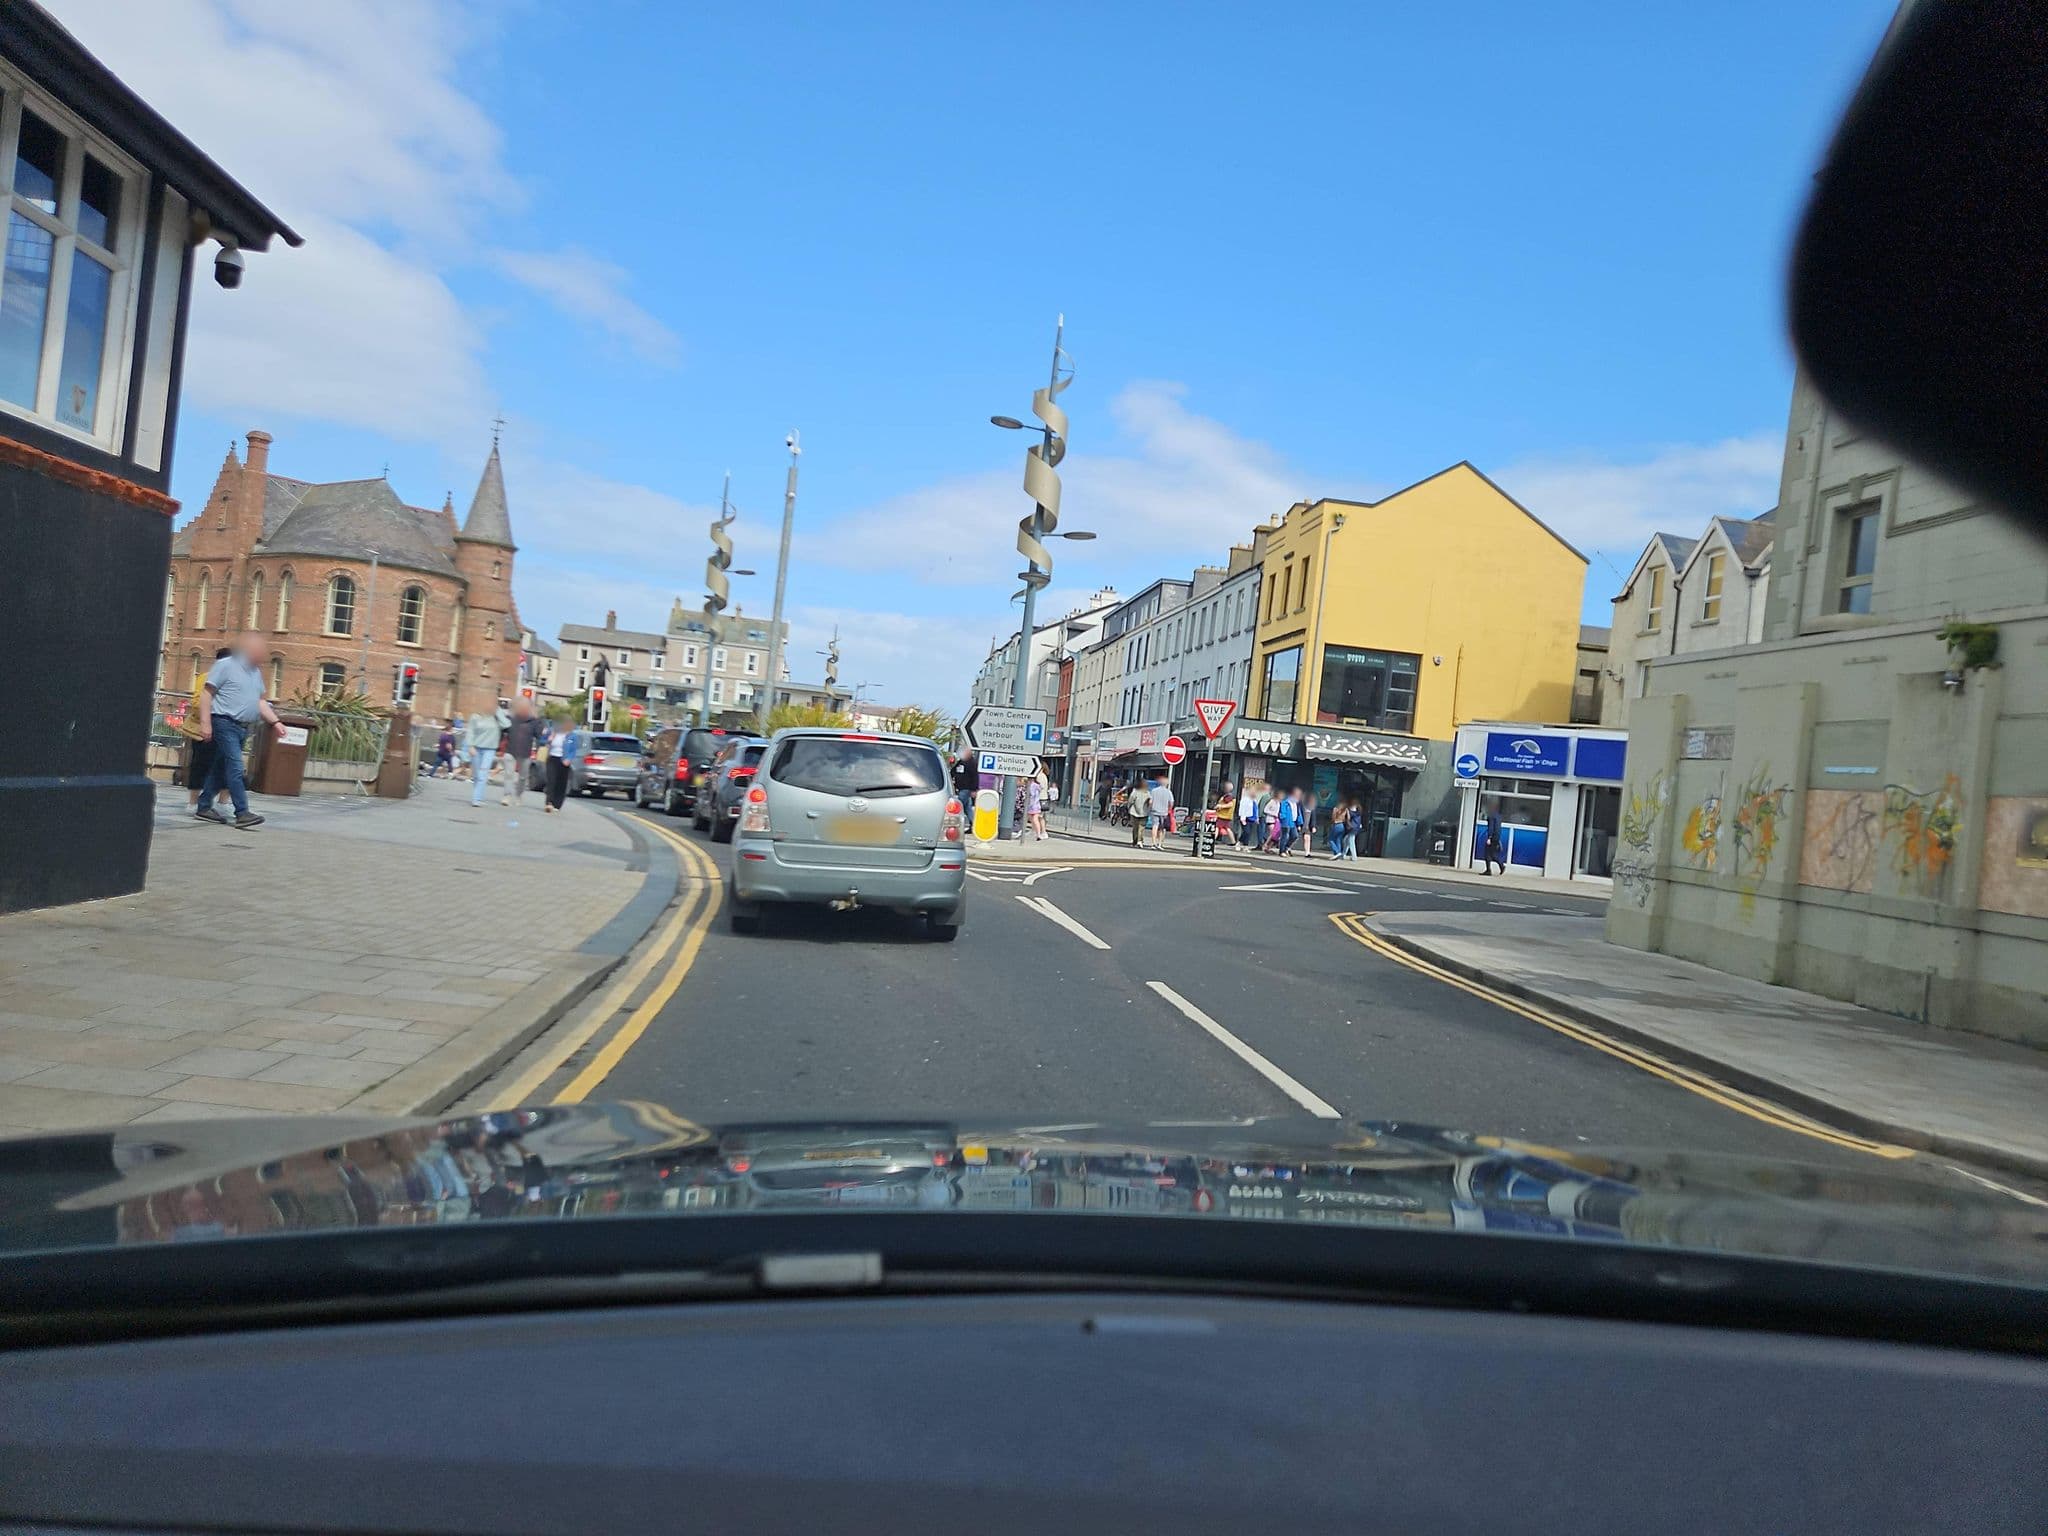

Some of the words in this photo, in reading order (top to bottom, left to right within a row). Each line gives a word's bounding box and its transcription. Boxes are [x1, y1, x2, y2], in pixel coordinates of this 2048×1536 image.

[1202, 705, 1225, 715] GIVE
[985, 710, 1004, 718] Town
[1006, 712, 1032, 720] Centre
[982, 730, 1014, 739] Harbour
[1236, 727, 1291, 744] MAUDS
[981, 740, 997, 748] 326
[999, 743, 1025, 751] spaces
[997, 755, 1028, 764] Dunluce
[1541, 759, 1559, 767] Chips
[997, 764, 1025, 773] Avenue
